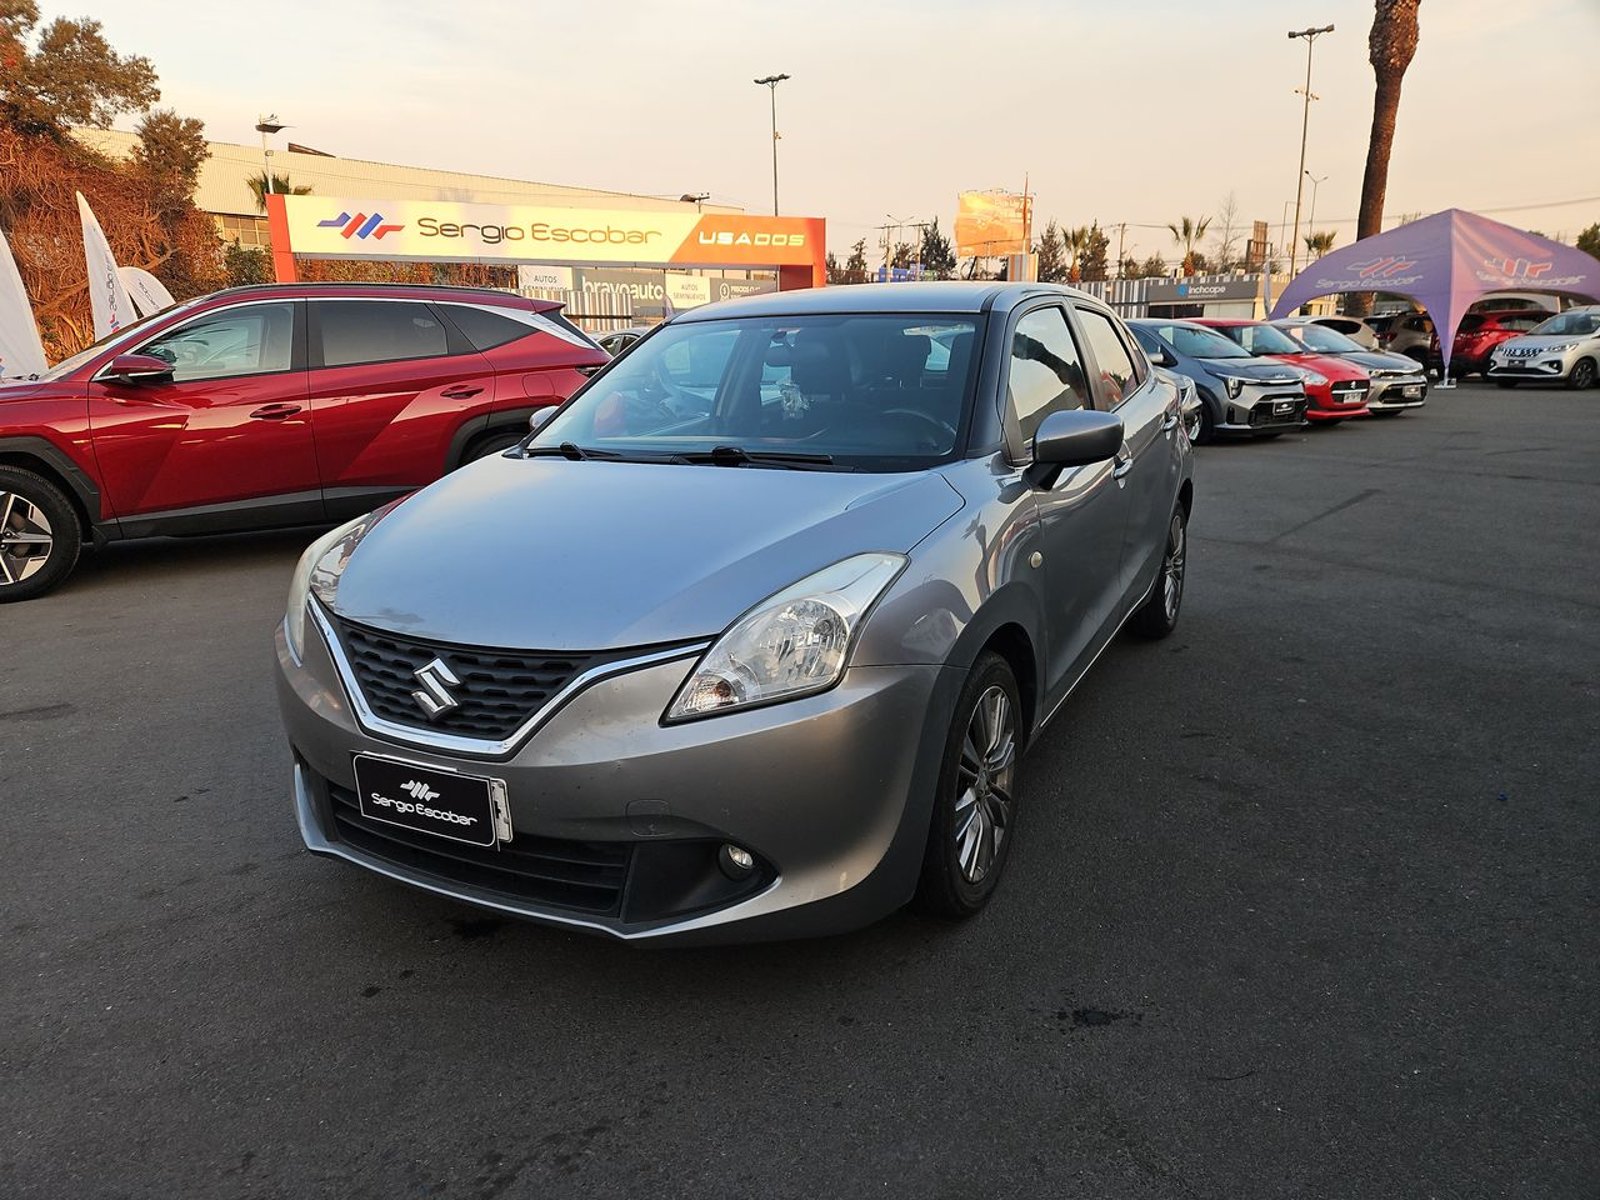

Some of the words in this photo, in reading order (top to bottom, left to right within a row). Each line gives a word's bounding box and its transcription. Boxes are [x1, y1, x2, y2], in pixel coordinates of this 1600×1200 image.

[417, 217, 525, 244] Sergio
[531, 222, 663, 244] Escobar
[699, 230, 805, 247] USADOS
[533, 275, 558, 283] AUTOS
[416, 803, 478, 826] Escobar
